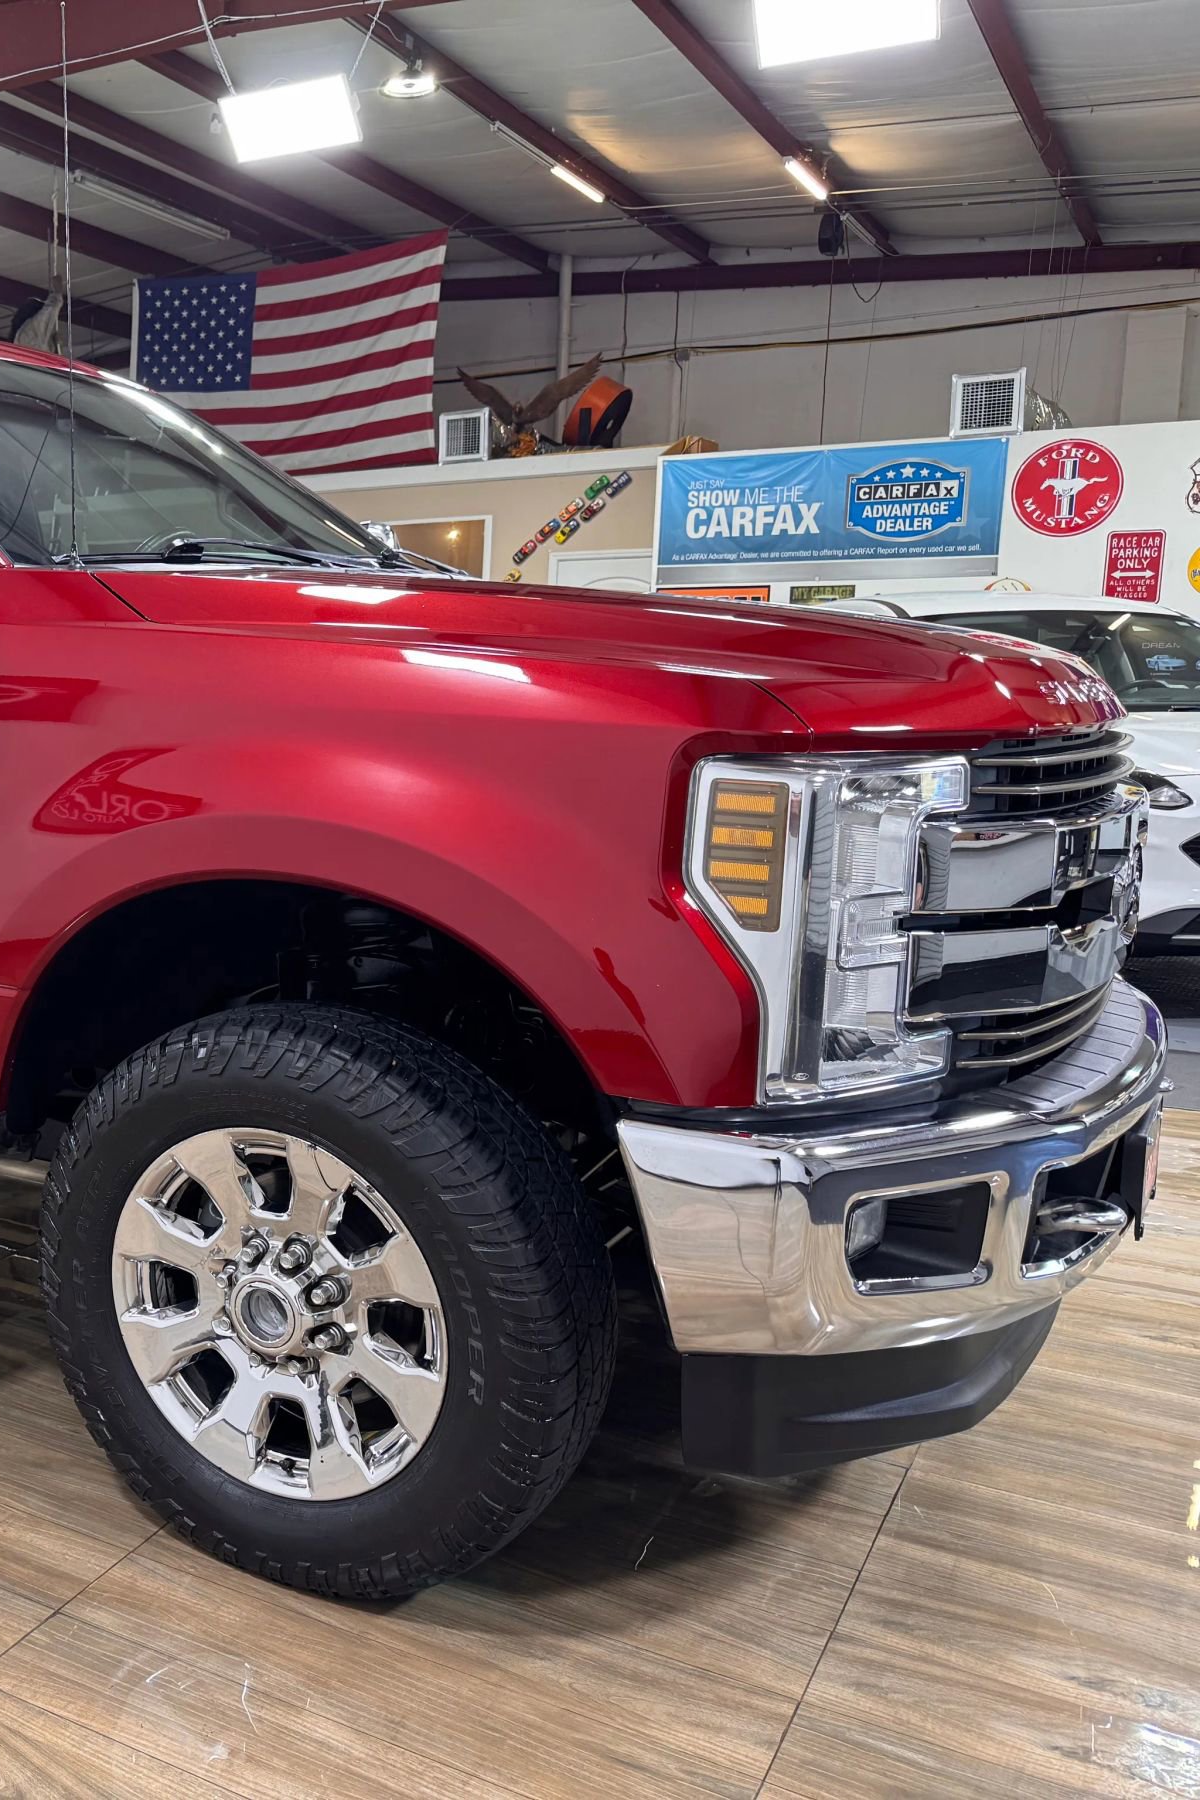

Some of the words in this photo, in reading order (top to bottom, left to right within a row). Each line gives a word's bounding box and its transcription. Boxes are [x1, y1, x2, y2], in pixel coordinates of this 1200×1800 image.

[1037, 446, 1100, 468] FORD
[687, 480, 708, 490] JUST
[709, 479, 725, 489] SAY
[858, 482, 956, 500] CARFAX
[687, 489, 740, 508] SHOW
[744, 487, 769, 505] ME
[774, 485, 805, 503] THE
[1022, 492, 1111, 528] MUSTANG
[685, 502, 821, 539] CARFAX
[875, 517, 933, 532] DEALER
[1111, 536, 1138, 548] RACE
[1141, 536, 1161, 547] CAR
[671, 553, 680, 561] As
[685, 552, 708, 561] CARFAX
[739, 551, 760, 560] Dealer,
[780, 550, 812, 559] committed
[819, 548, 842, 558] offering
[877, 547, 899, 556] Report
[908, 546, 926, 555] every
[927, 545, 944, 553] used
[968, 543, 982, 551] sell.
[1111, 548, 1159, 559] PARKING
[1117, 558, 1150, 569] ONLY
[792, 587, 809, 600] MY
[810, 586, 854, 599] GARAGE
